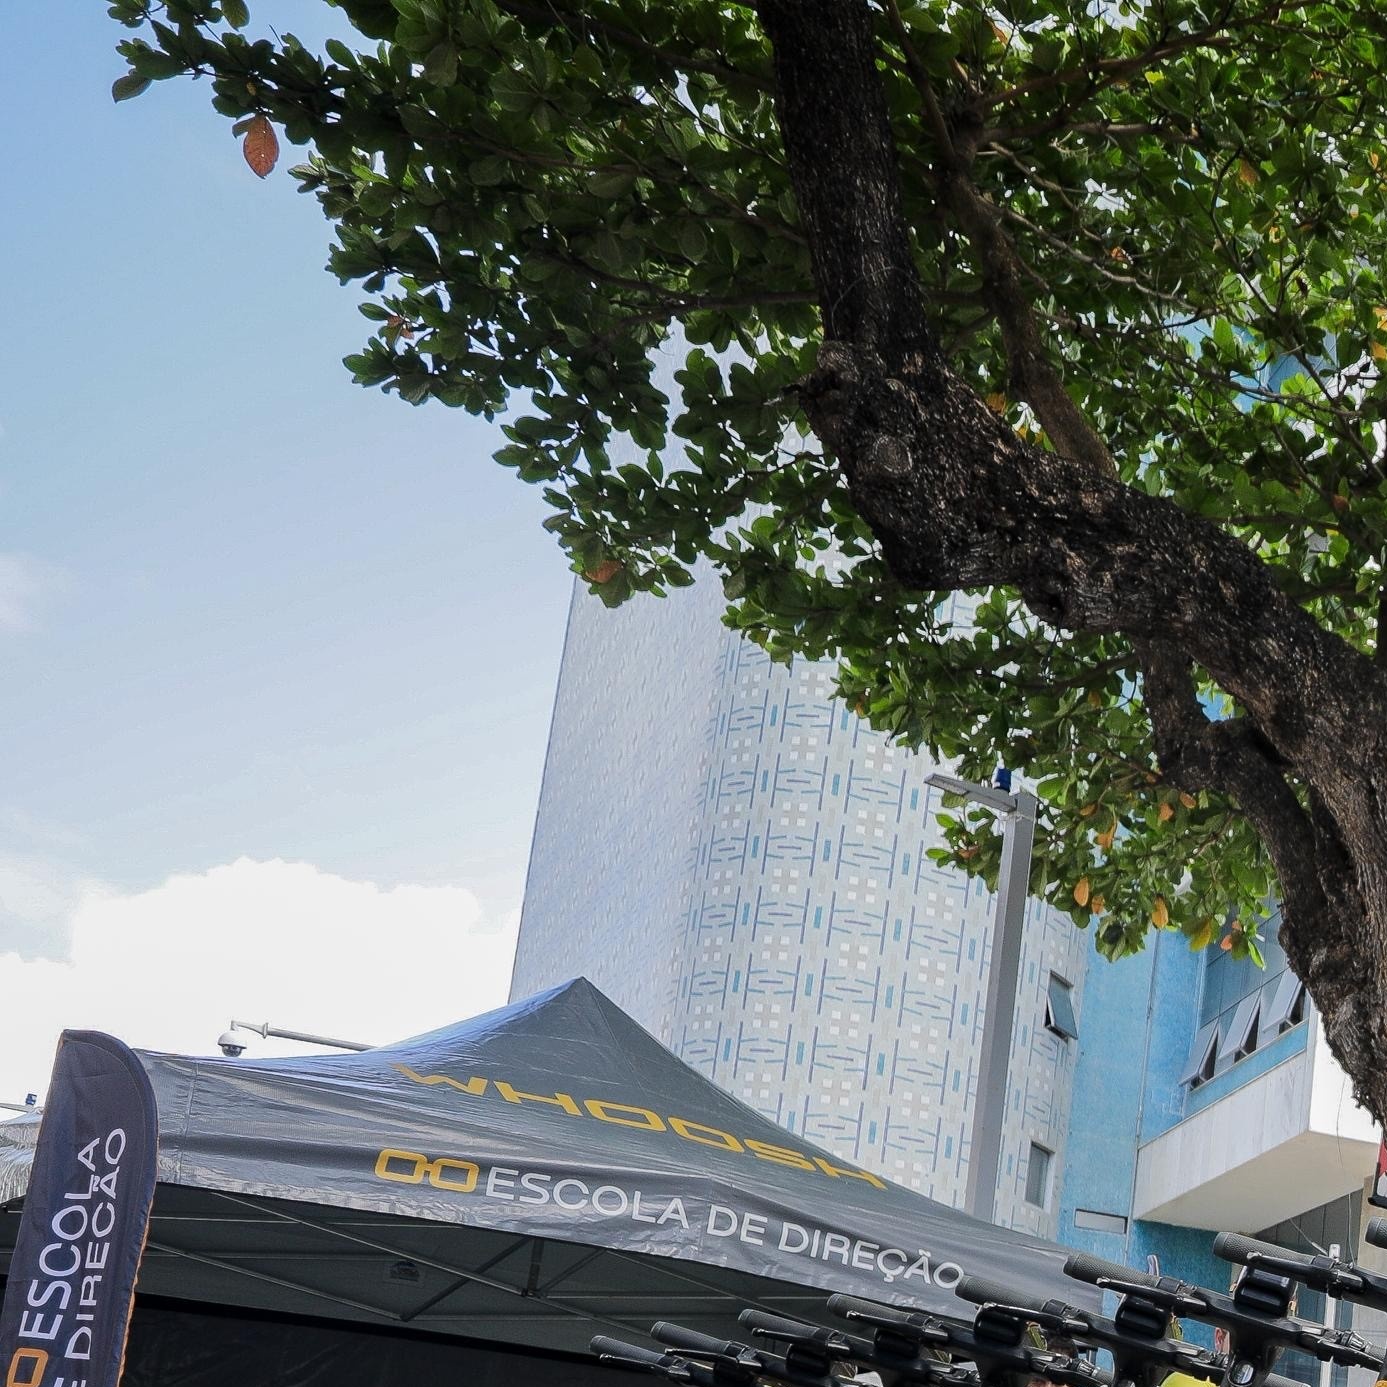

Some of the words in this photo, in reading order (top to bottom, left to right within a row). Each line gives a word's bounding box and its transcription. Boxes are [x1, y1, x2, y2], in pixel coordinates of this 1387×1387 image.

[390, 1062, 888, 1190] WHOOSH
[18, 1137, 101, 1340] ESCOLA
[485, 1166, 690, 1229] ESCOLA
[706, 1204, 768, 1246] DE
[778, 1221, 964, 1289] DIREÇÃO
